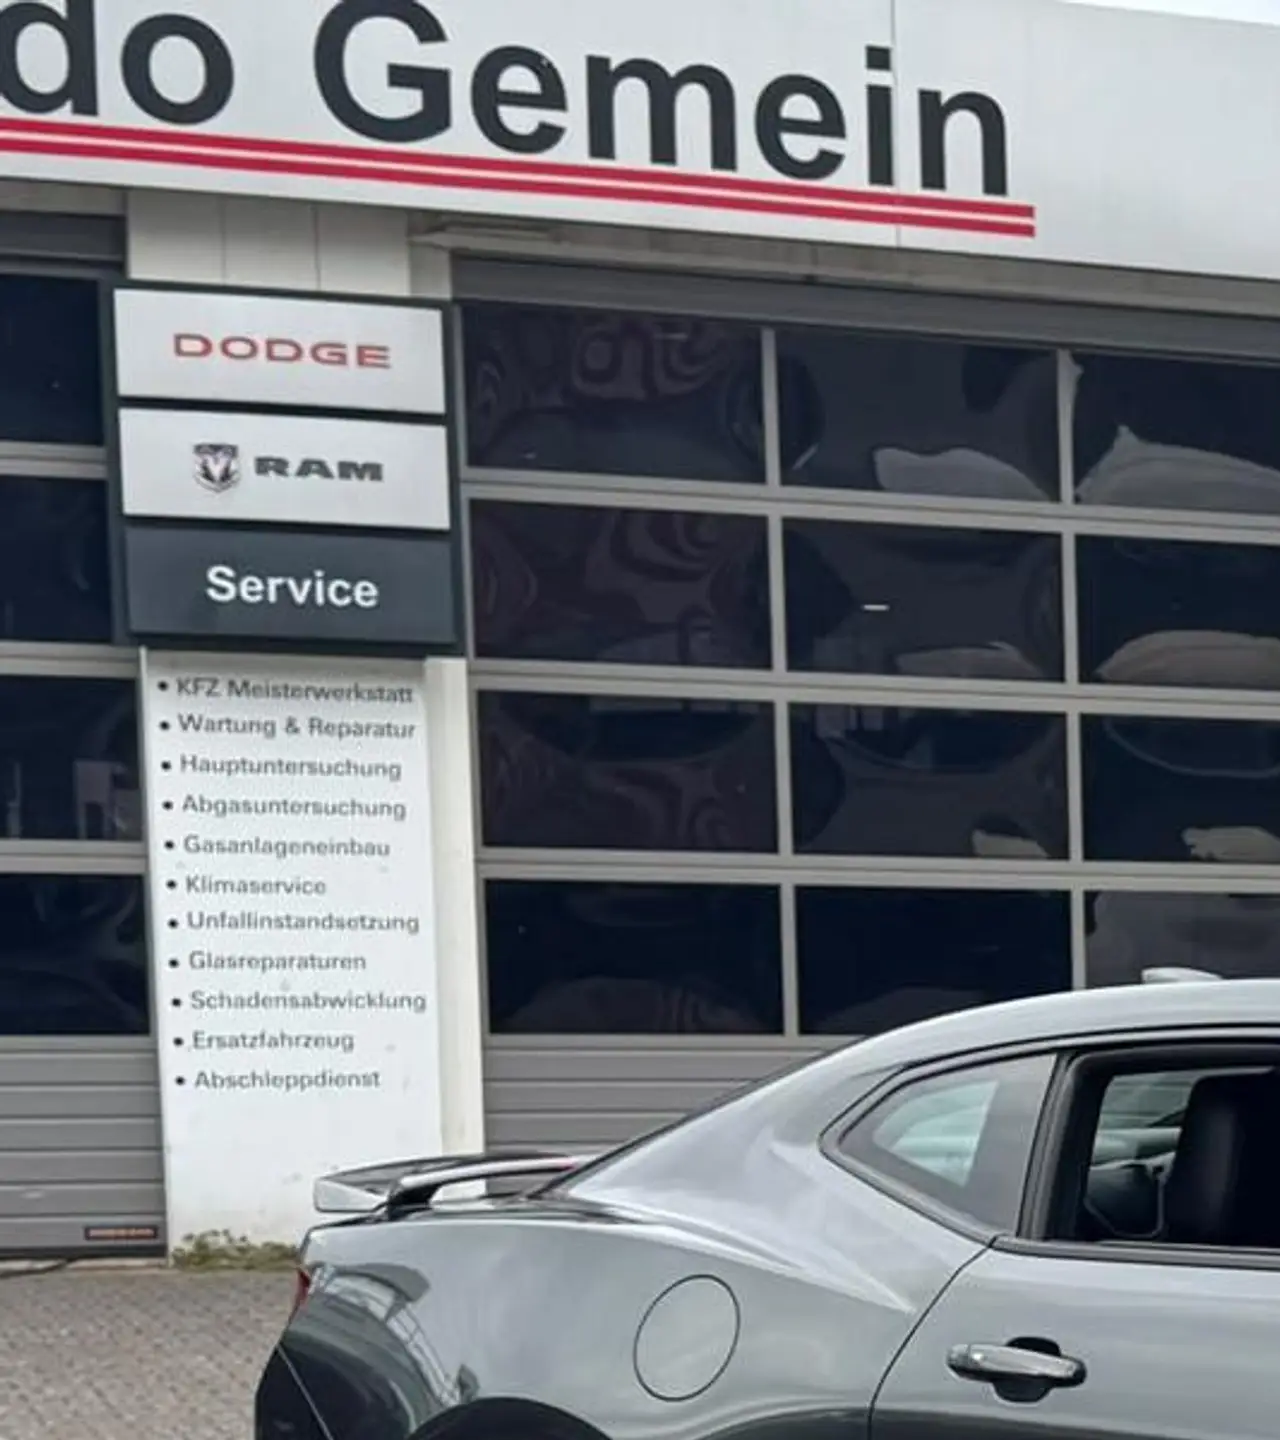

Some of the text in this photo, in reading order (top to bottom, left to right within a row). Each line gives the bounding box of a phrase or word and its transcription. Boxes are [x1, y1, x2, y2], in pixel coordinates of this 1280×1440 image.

[312, 0, 1007, 197] Gemein
[172, 333, 391, 370] DODGE
[254, 456, 384, 482] RAM
[205, 564, 379, 608] Service
[176, 678, 415, 703] KFZ Meisterwerkstatt
[178, 714, 416, 740] Wartung & Reparatur
[179, 754, 402, 781] Hauptuntersuchung
[181, 795, 407, 821] Abgasuntersuchung
[183, 836, 391, 859] Gasanlageneinbau
[185, 876, 327, 895] Klimaservice
[187, 911, 420, 934] Unfallinstandsetzung
[188, 950, 367, 972] Glasreparaturen
[190, 990, 427, 1013] Schadensabwicklung
[192, 1031, 355, 1053] Ersatzfahrzeug
[194, 1070, 381, 1092] Abschleppdienst
